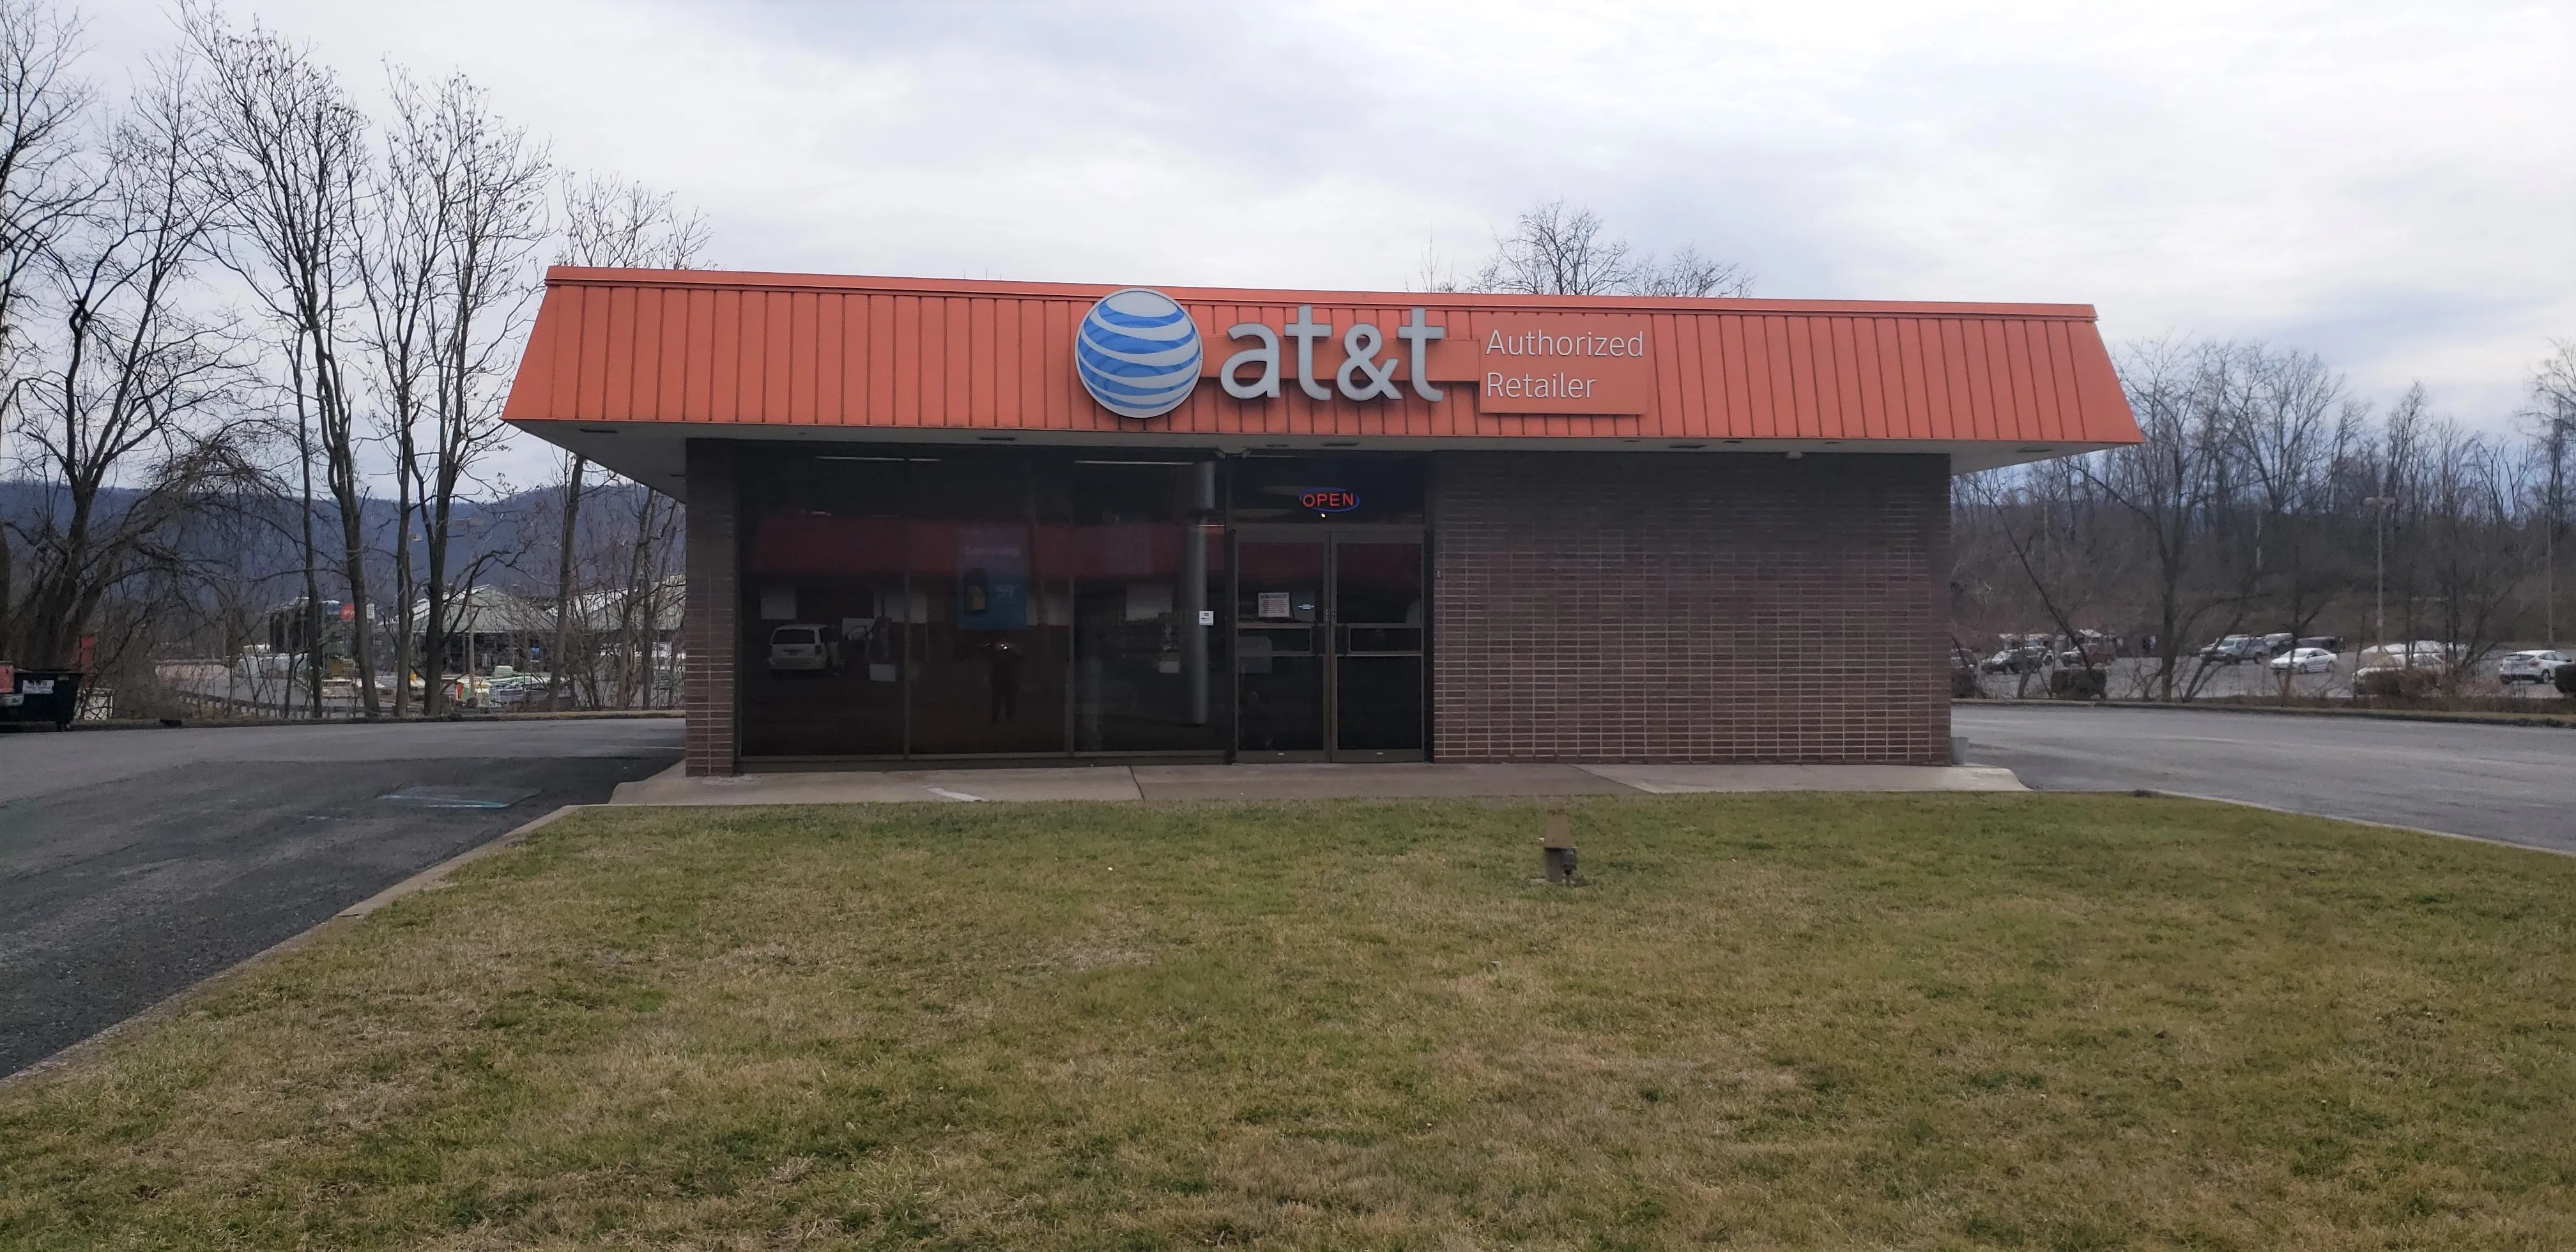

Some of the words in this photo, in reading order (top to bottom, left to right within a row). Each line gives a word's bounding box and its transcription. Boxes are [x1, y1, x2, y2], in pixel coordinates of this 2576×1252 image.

[1220, 305, 1445, 402] at&t
[1485, 329, 1643, 357] Authorized
[1487, 372, 1597, 398] Retailer
[1302, 492, 1354, 507] OPEN
